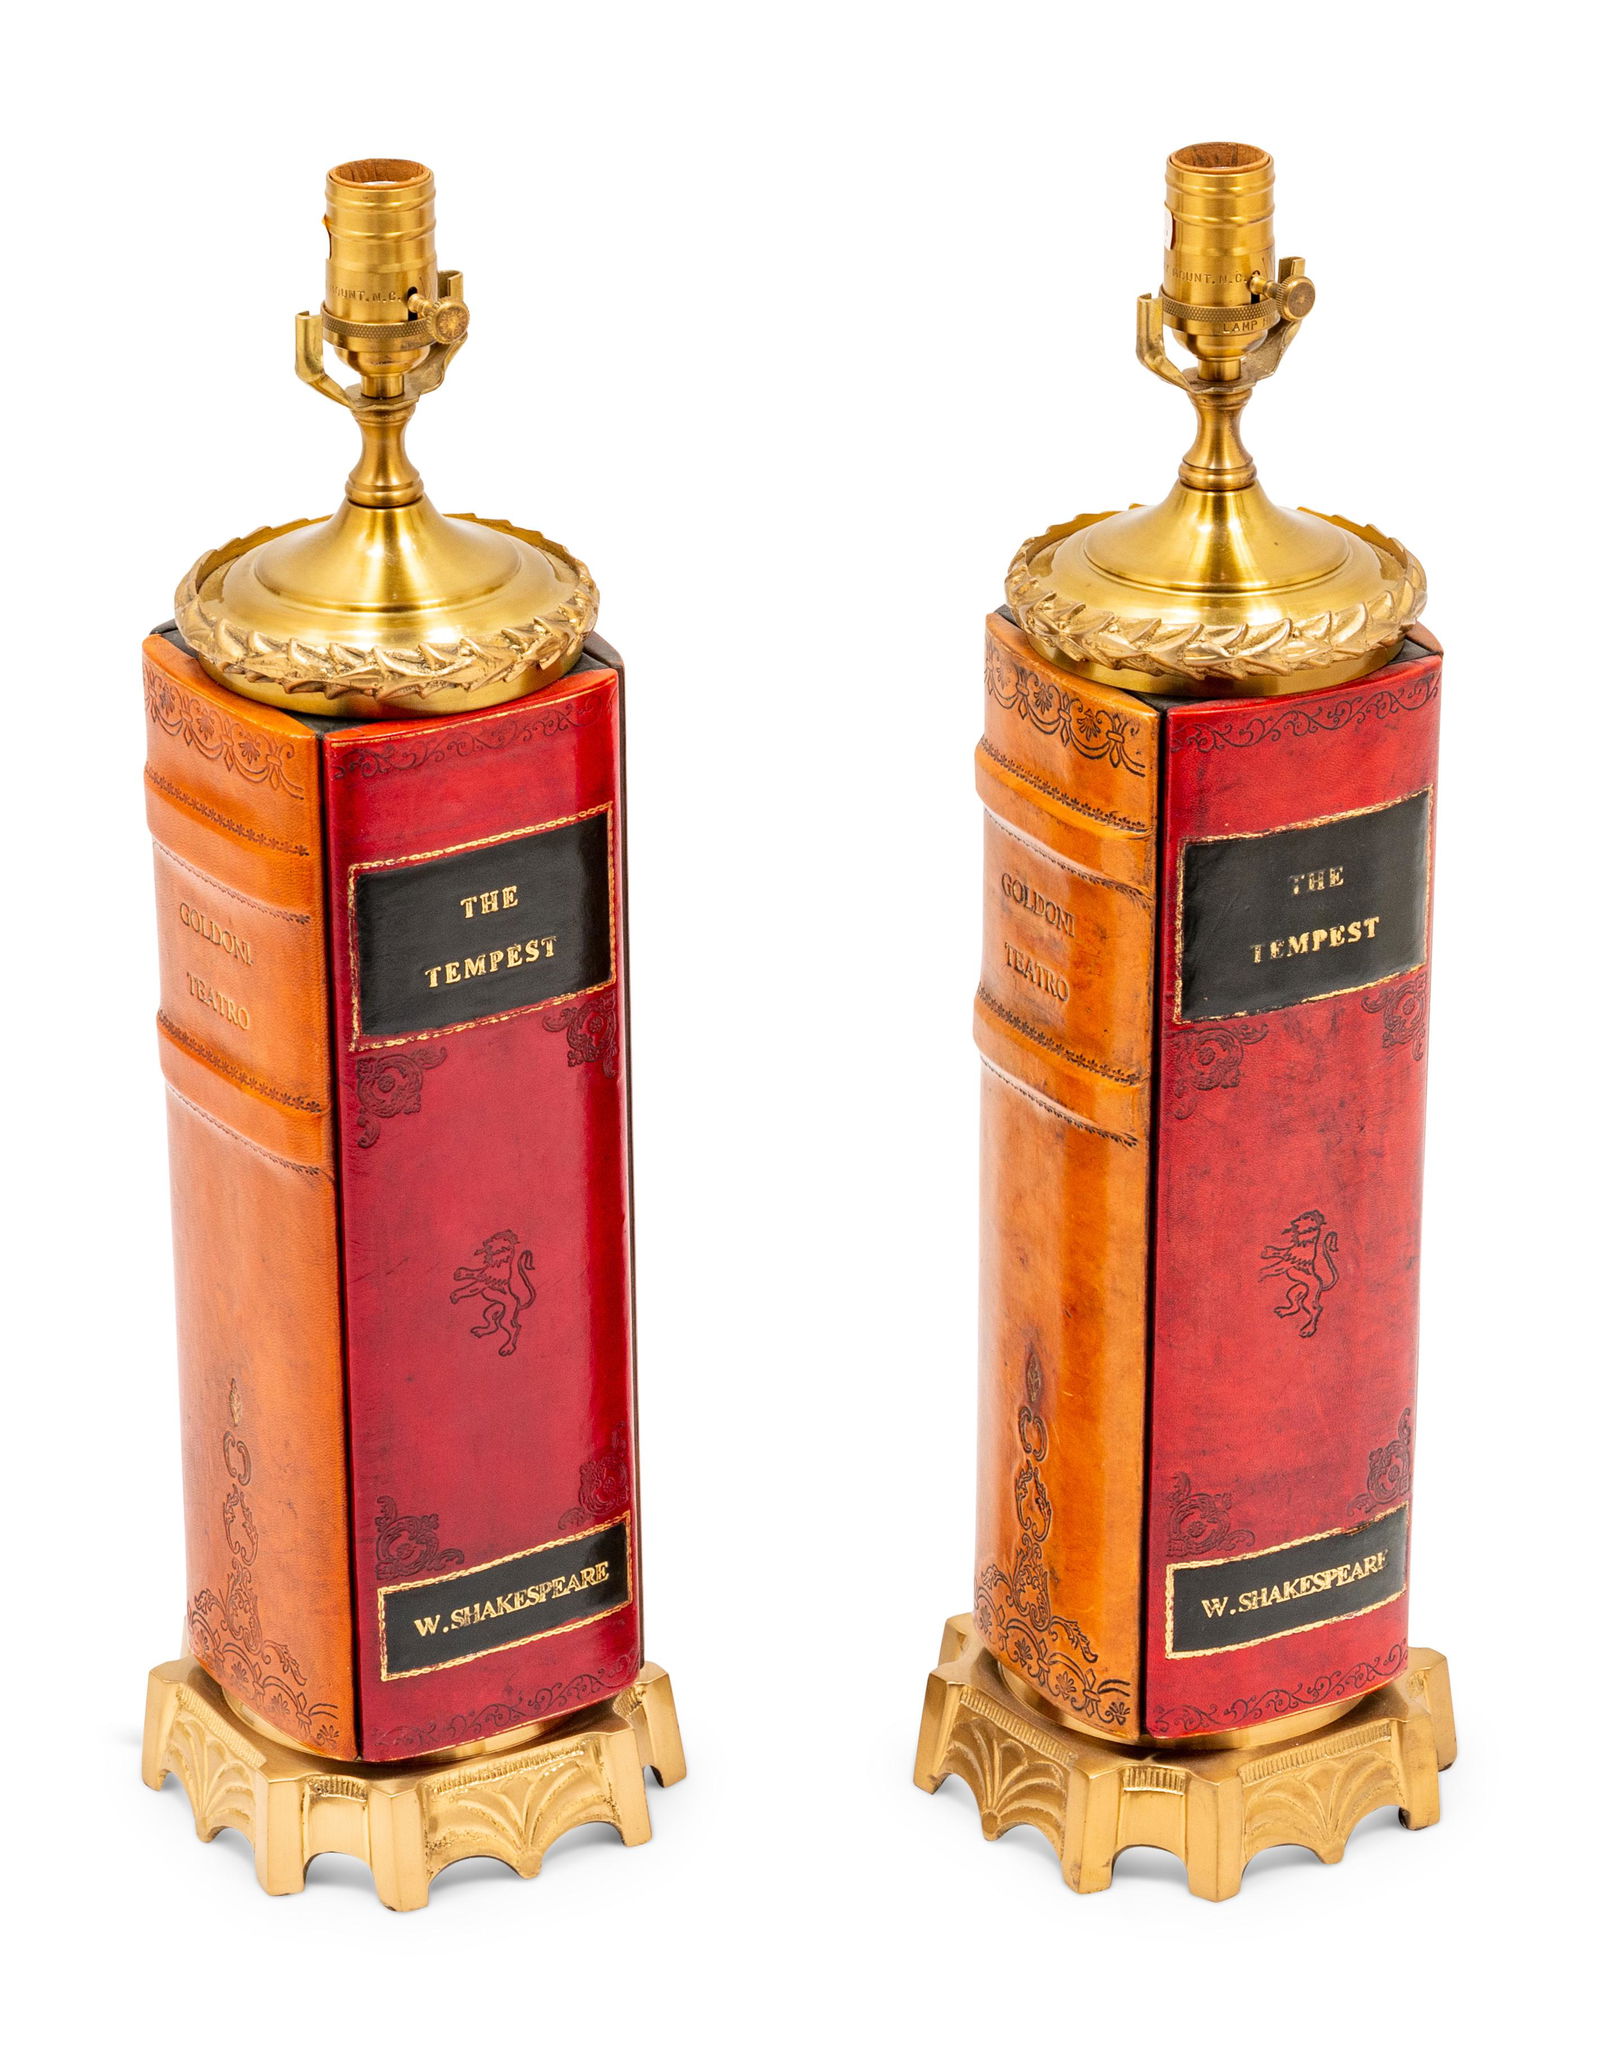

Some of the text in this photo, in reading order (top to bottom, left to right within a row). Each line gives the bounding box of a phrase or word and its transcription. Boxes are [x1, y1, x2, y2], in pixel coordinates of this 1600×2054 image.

[1223, 320, 1258, 332] LAMP
[461, 885, 519, 919] THE
[1001, 872, 1075, 938] GOLDONI
[1290, 865, 1345, 895] THE
[180, 902, 254, 967] GOLDONI
[1249, 916, 1380, 964] TEMPEST
[425, 935, 558, 988] TEMPEST
[1004, 941, 1069, 1002] TEATRO
[187, 971, 250, 1030] TEATRO
